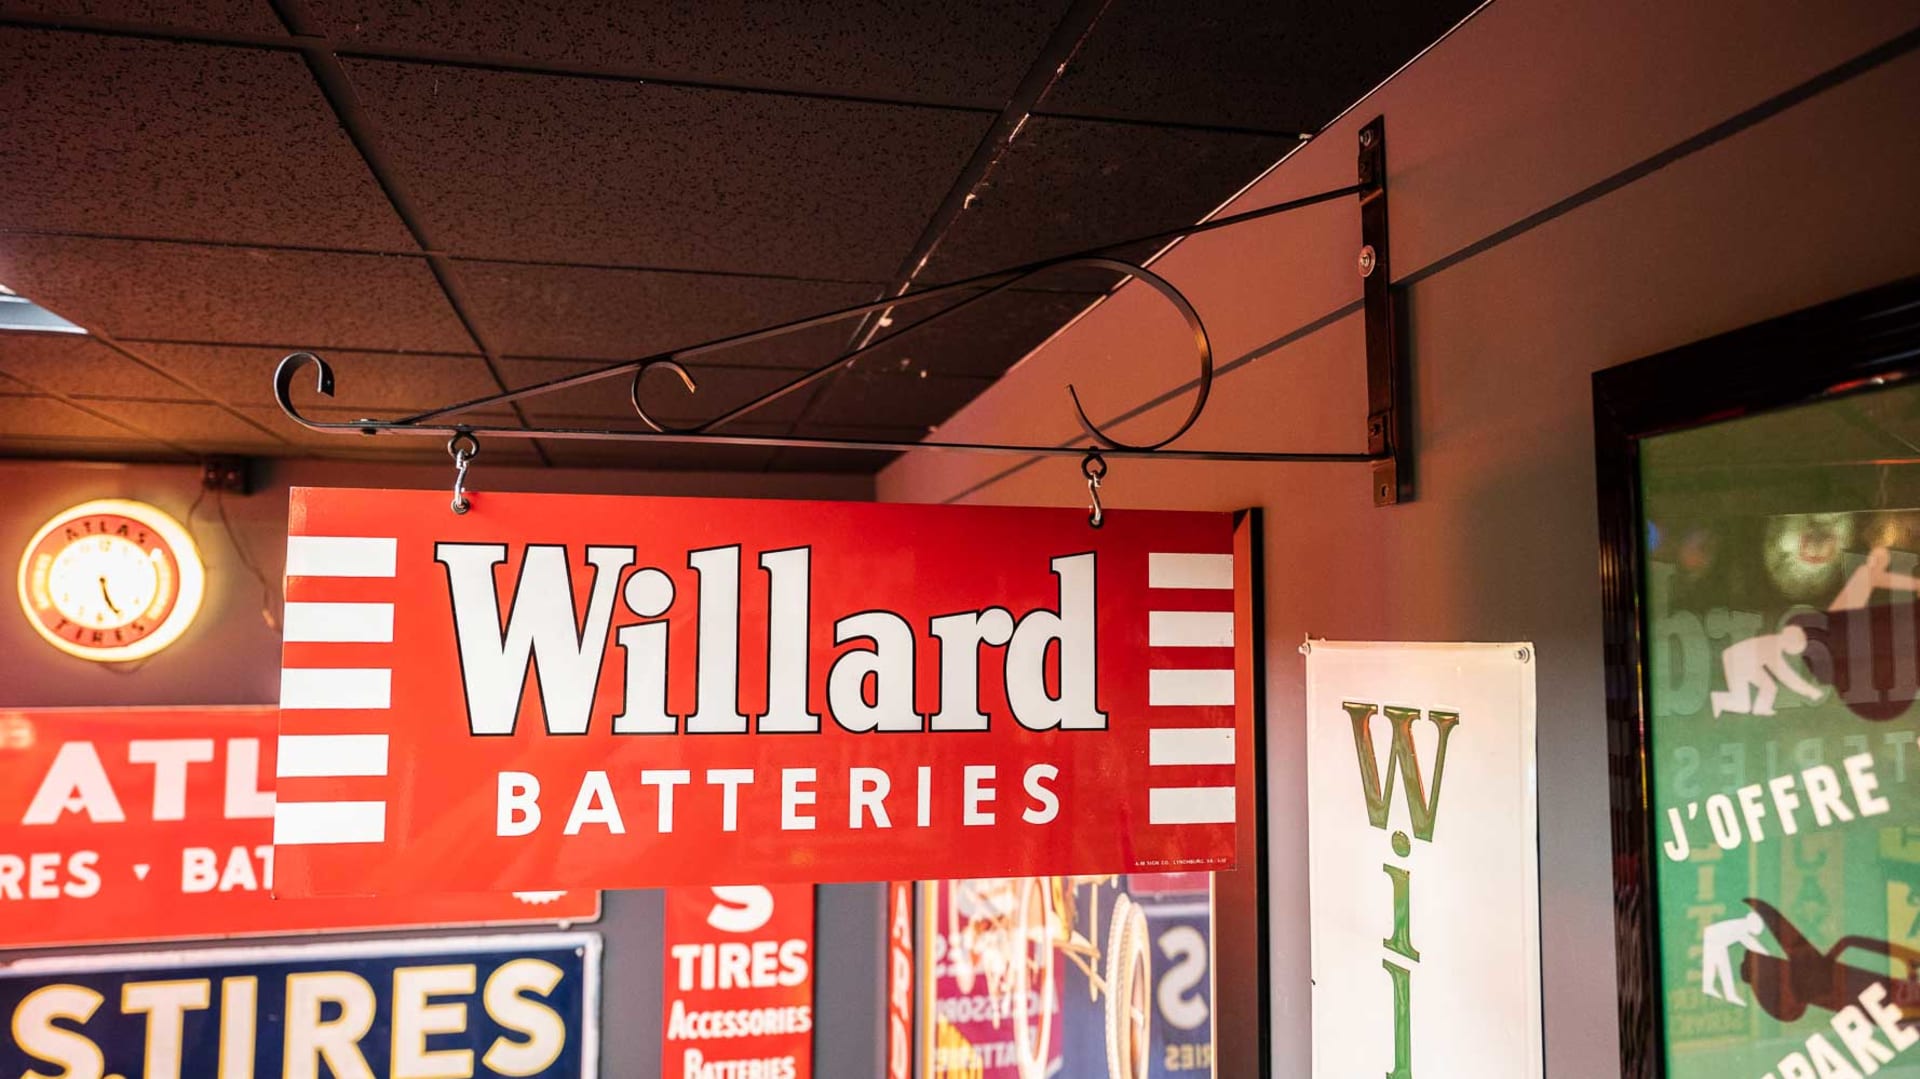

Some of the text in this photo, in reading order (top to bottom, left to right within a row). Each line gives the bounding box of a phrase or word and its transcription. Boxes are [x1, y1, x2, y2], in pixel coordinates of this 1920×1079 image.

[66, 520, 146, 545] ATLAS
[55, 618, 145, 643] TIRES
[434, 541, 1109, 737] Willard
[494, 763, 1060, 837] BATTERIES
[1663, 752, 1891, 862] J'OFFRE
[671, 938, 810, 992] TIRES
[11, 958, 567, 1079] STIRES
[1761, 982, 1920, 1079] PARE
